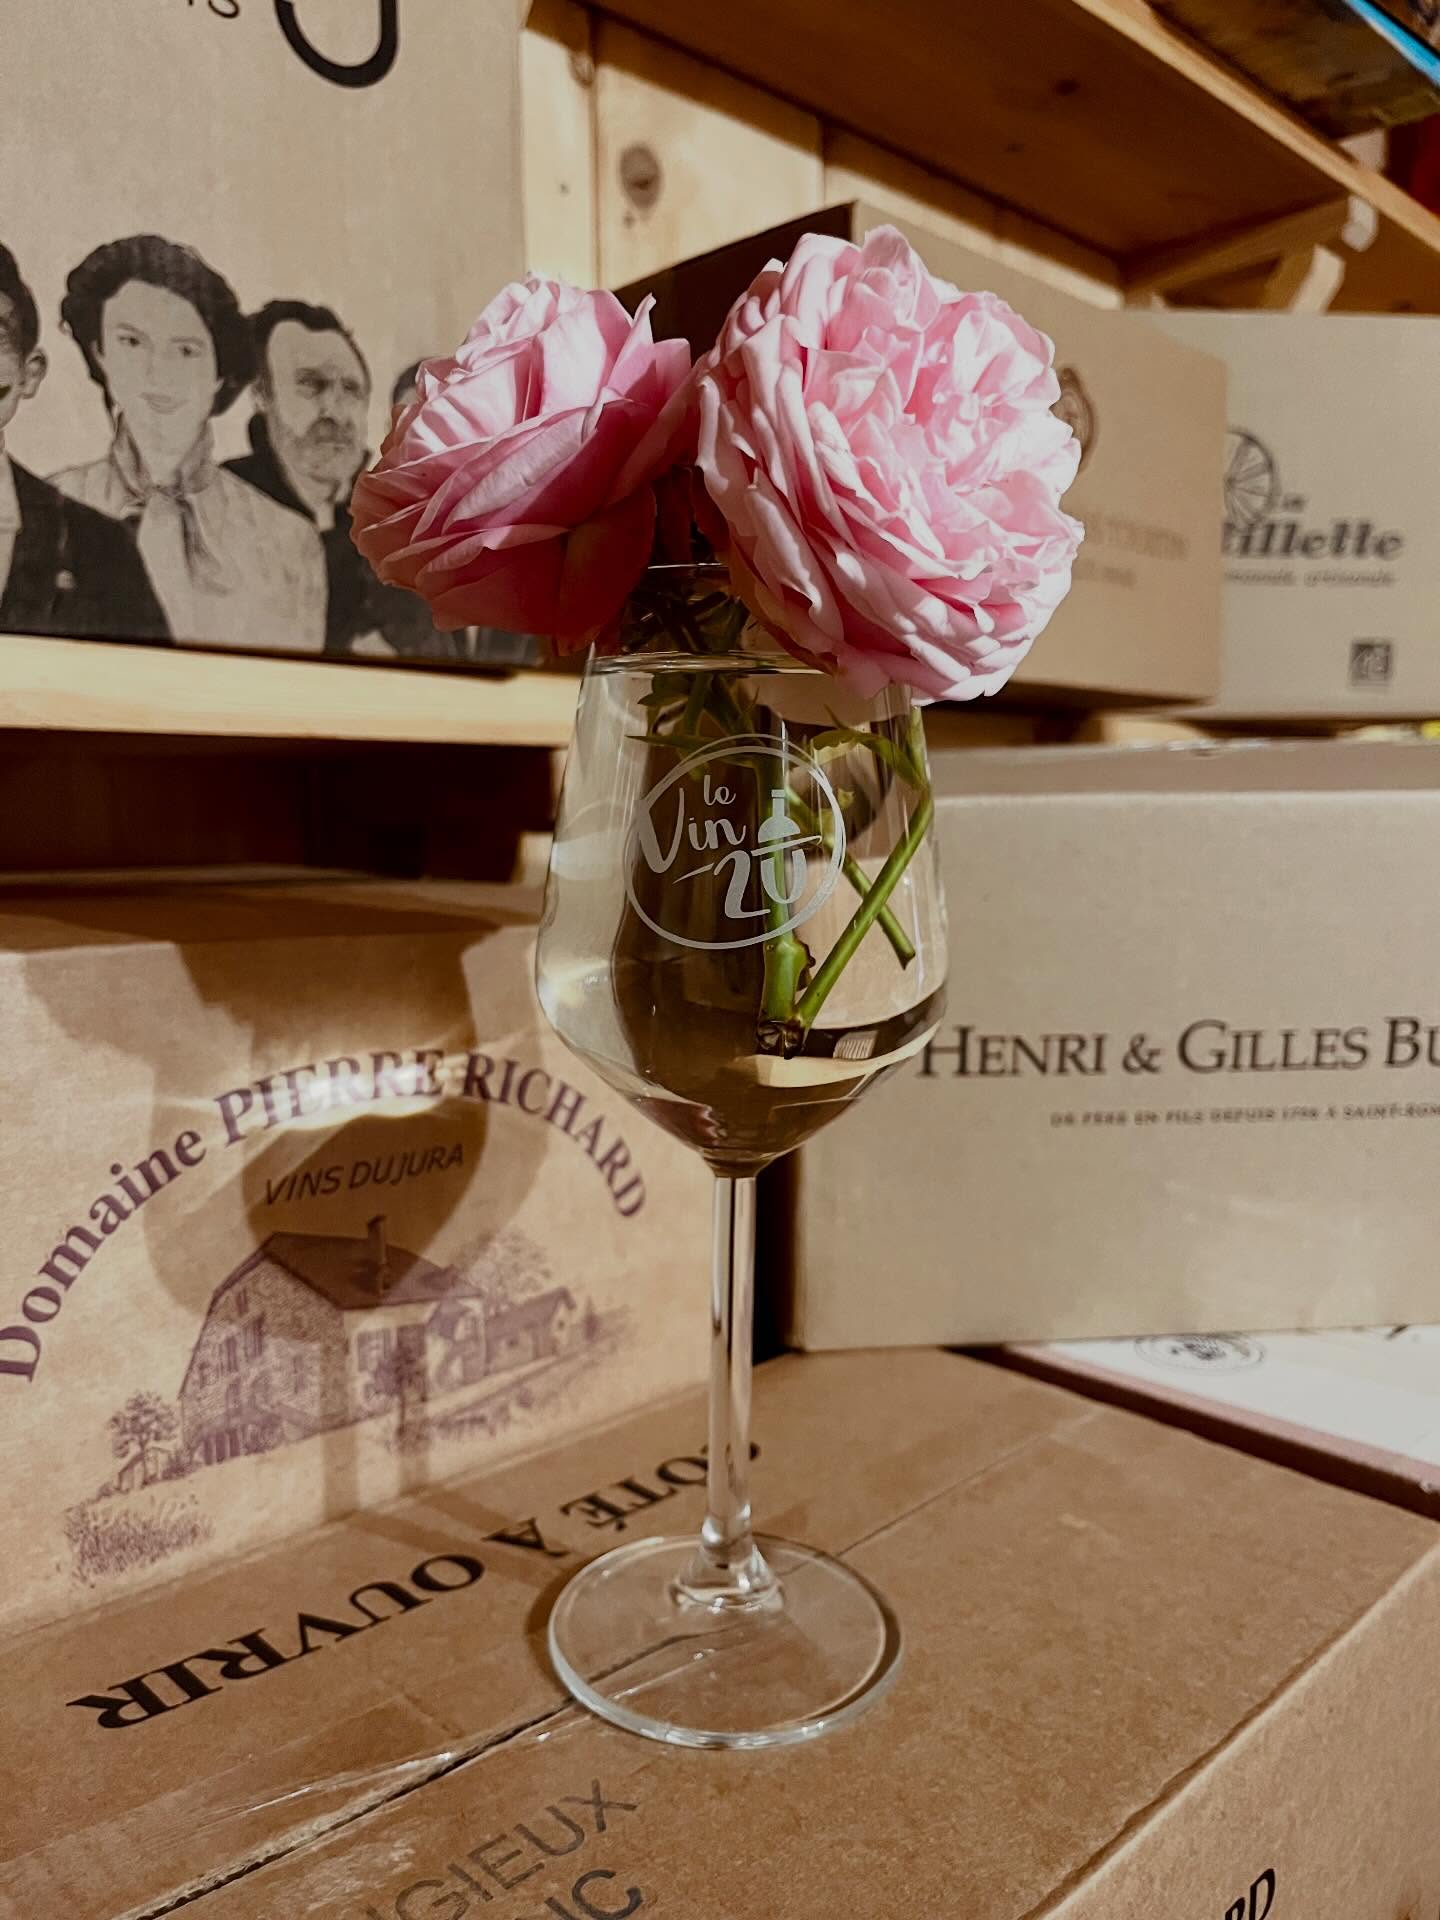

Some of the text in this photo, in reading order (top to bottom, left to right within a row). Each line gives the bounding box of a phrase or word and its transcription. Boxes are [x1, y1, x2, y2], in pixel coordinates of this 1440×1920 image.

[703, 774, 737, 806] le
[638, 787, 747, 874] Vin
[917, 1024, 1107, 1078] HENRI
[1121, 1032, 1163, 1076] &
[1177, 1018, 1369, 1074] GILLES
[0, 1048, 648, 1383] Domaine PIERRE RICHARD
[266, 1165, 345, 1206] VINS
[66, 1554, 486, 1729] OUVRIR
